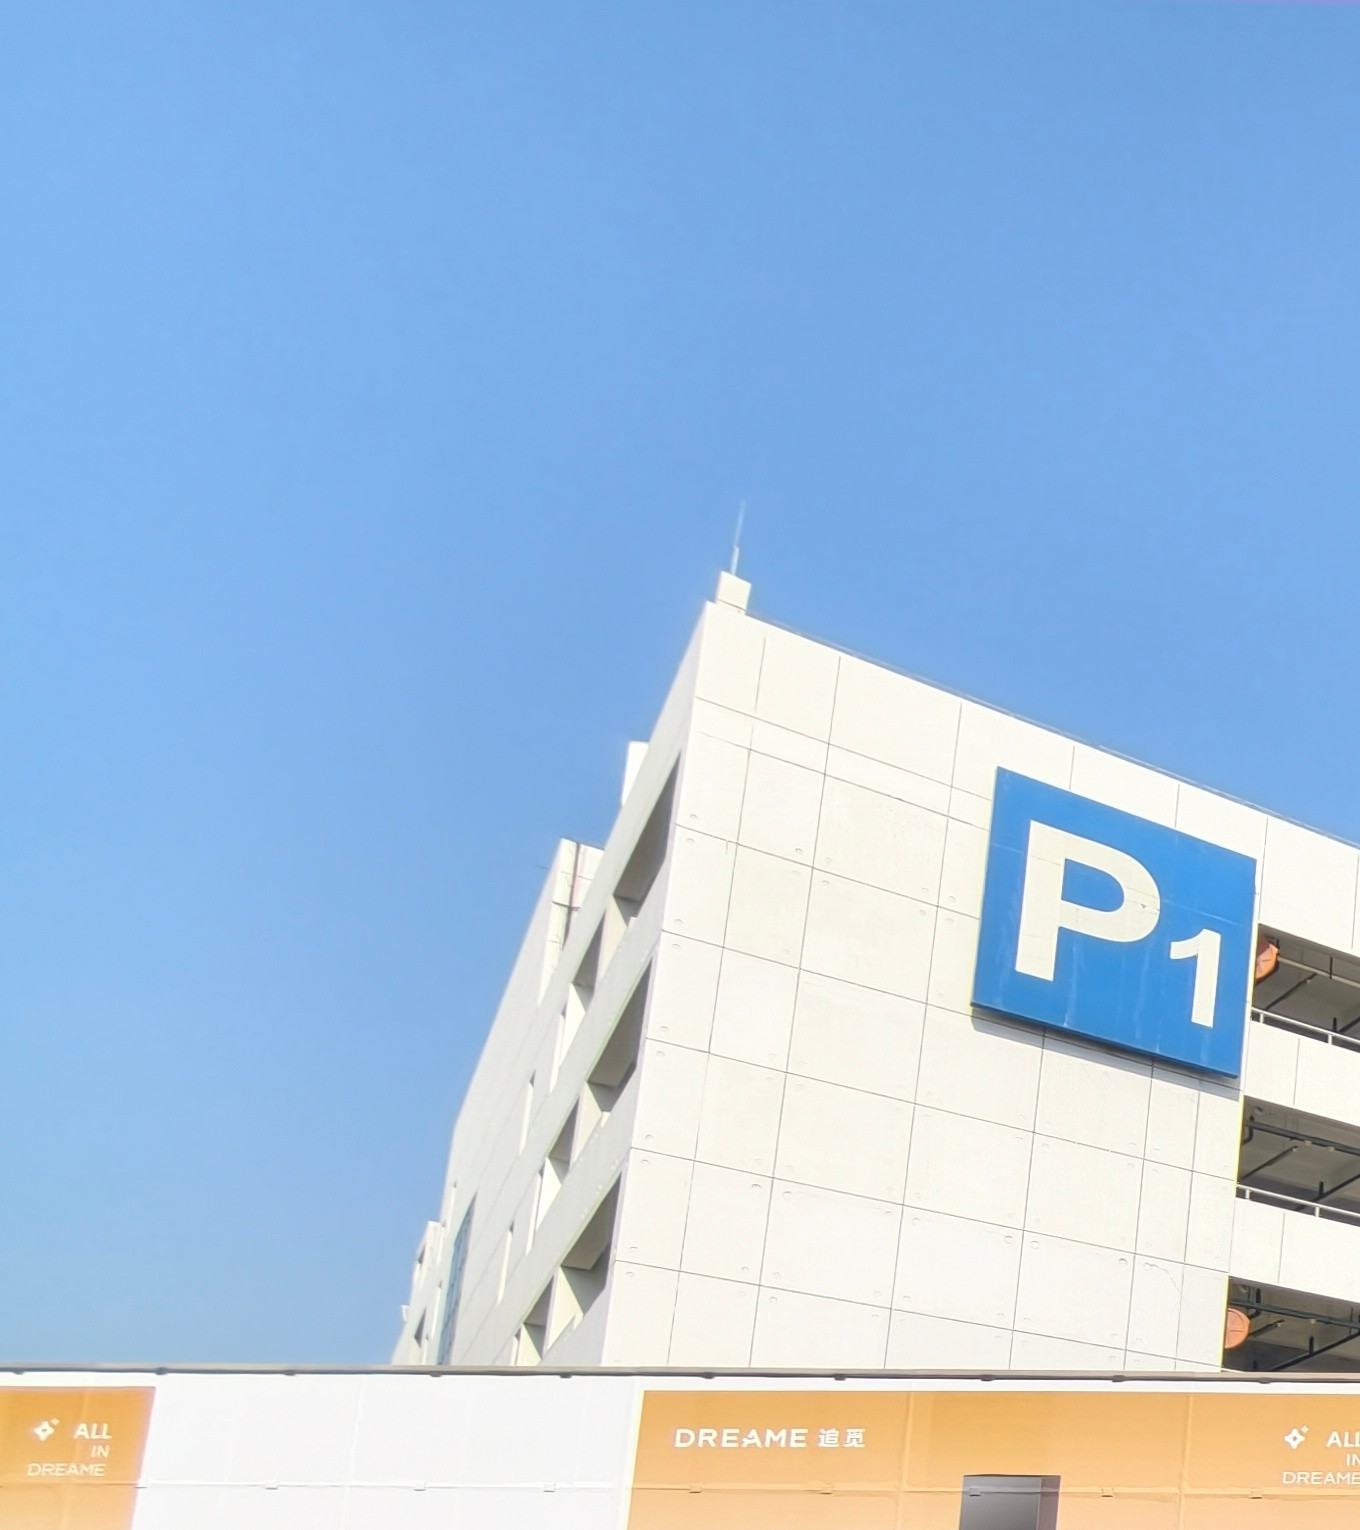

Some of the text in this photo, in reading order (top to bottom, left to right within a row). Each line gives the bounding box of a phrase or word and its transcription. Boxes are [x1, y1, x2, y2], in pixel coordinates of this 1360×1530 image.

[74, 1422, 112, 1440] ALL
[674, 1428, 809, 1448] DREAME
[90, 1445, 110, 1458] IN
[27, 1462, 107, 1477] DREAME
